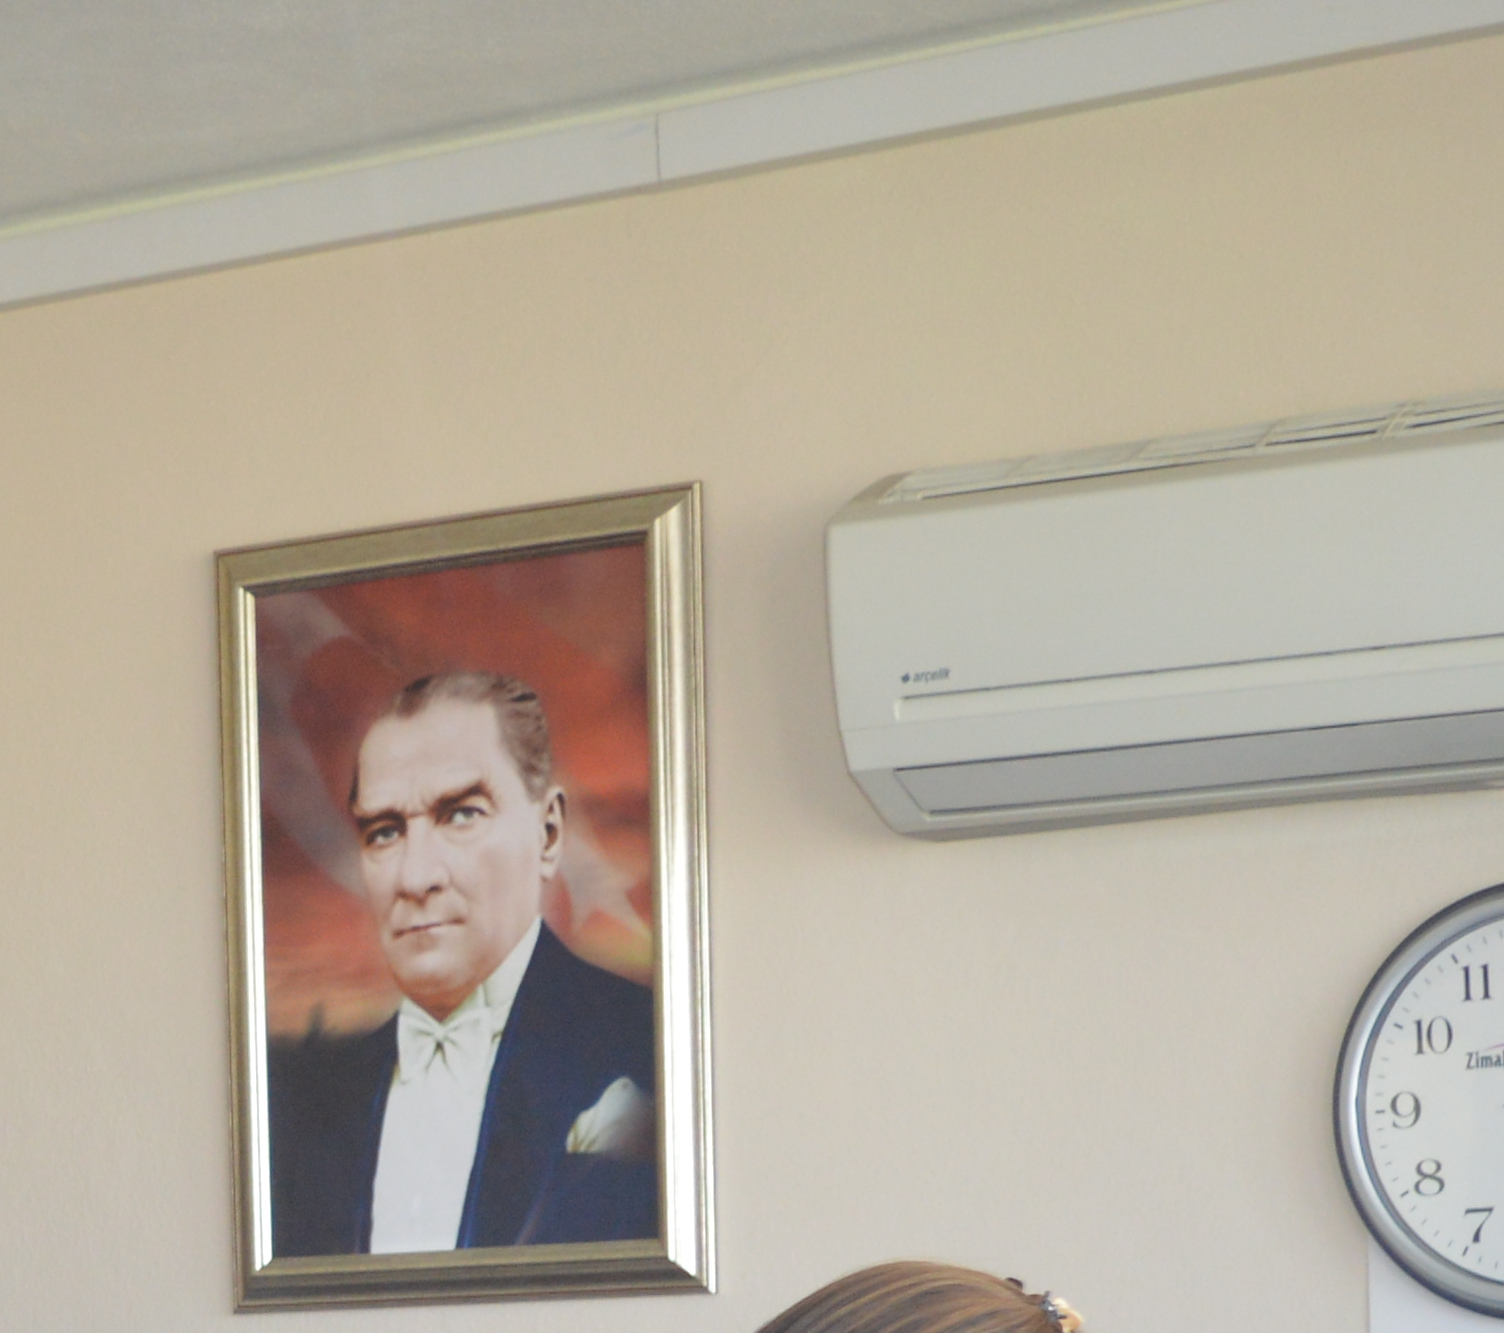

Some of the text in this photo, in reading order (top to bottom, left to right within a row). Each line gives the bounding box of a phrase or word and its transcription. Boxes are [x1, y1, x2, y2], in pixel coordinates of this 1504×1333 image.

[1461, 963, 1492, 1001] 11
[1414, 1015, 1453, 1055] 10
[1390, 1091, 1422, 1128] 9
[1414, 1158, 1446, 1196] 8
[1464, 1207, 1494, 1244] 7
